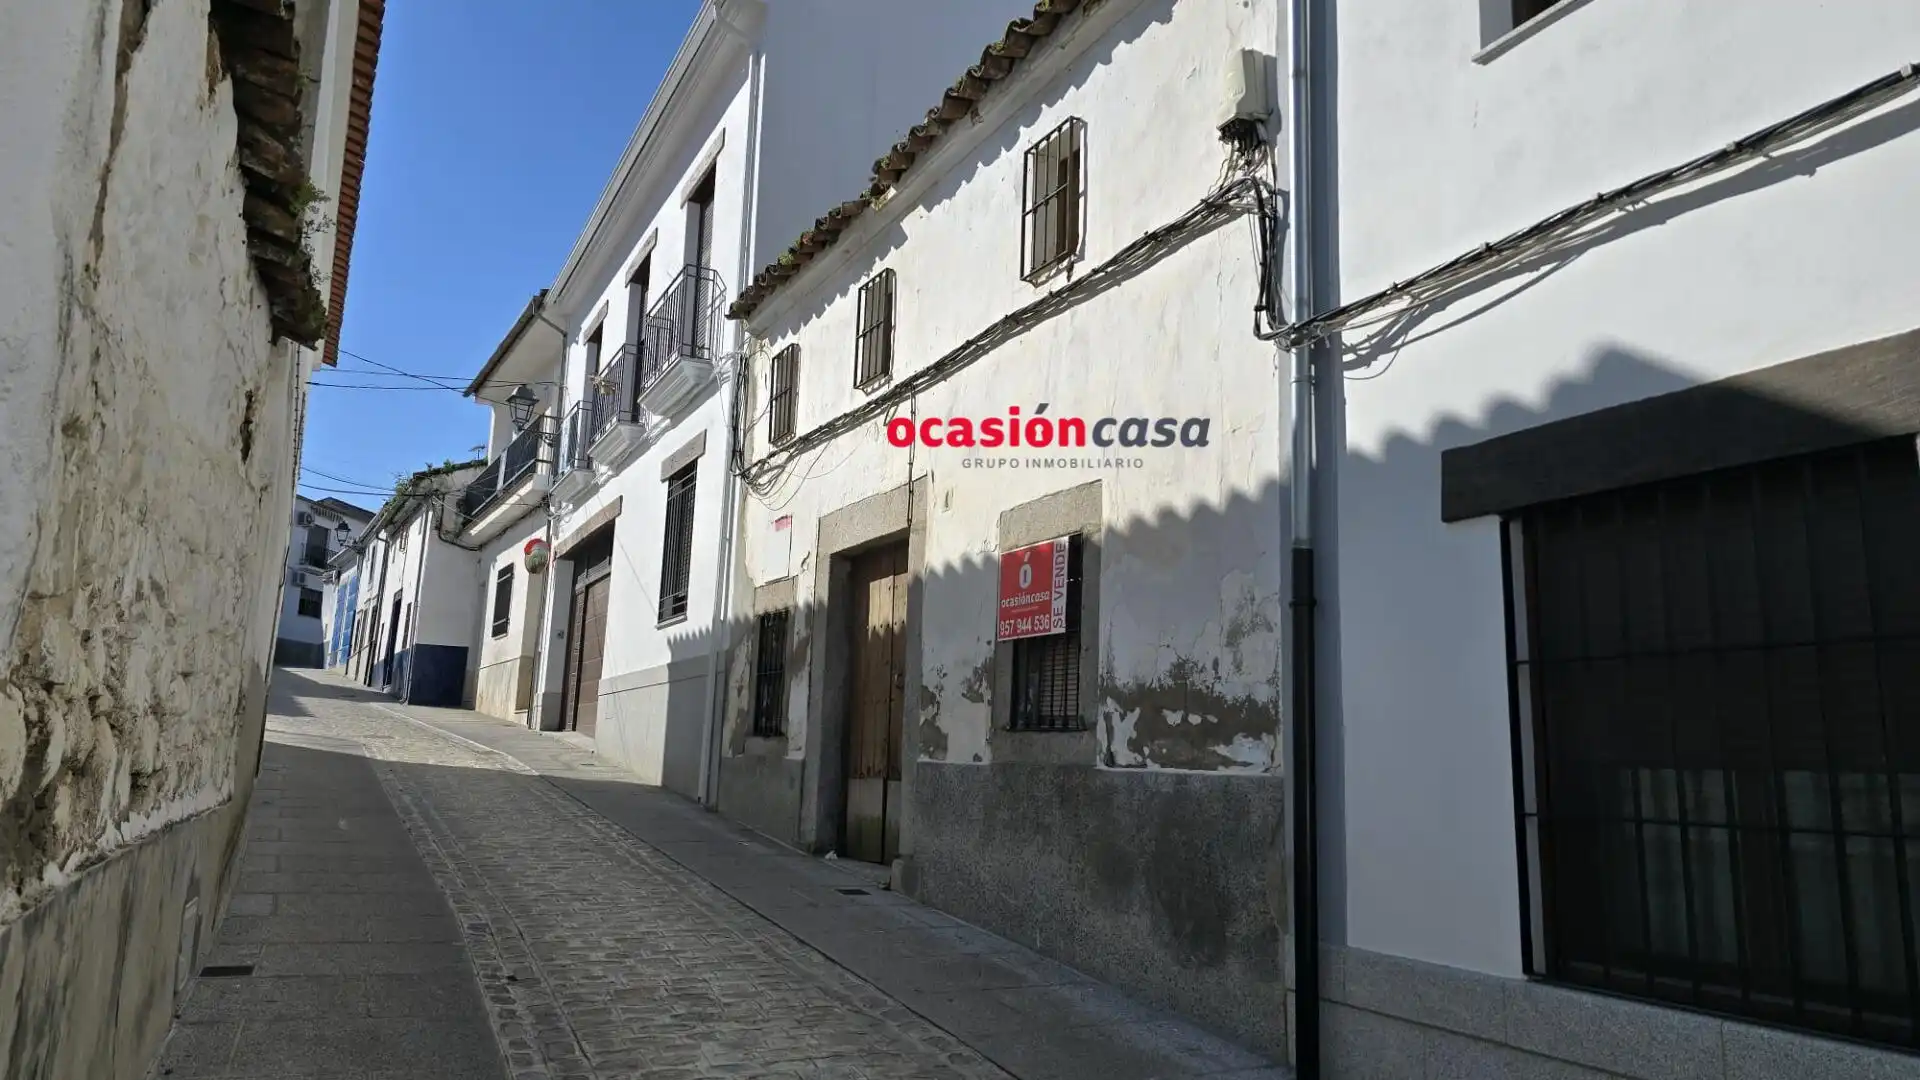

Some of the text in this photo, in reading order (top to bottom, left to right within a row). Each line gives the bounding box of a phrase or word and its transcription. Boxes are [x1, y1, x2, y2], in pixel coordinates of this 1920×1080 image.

[1053, 543, 1066, 628] SE VENDE
[1000, 614, 1050, 635] 957 944 536
